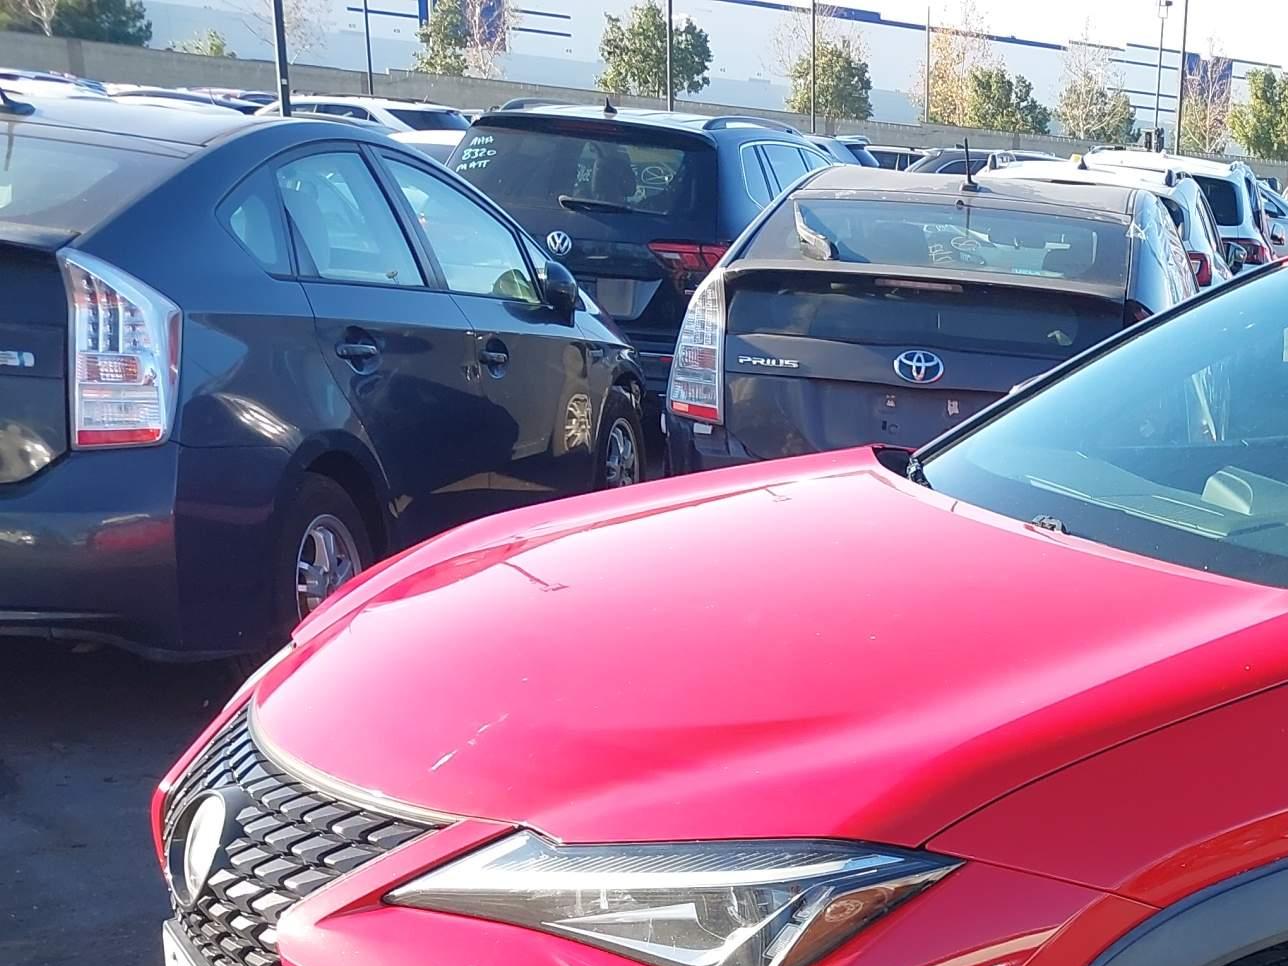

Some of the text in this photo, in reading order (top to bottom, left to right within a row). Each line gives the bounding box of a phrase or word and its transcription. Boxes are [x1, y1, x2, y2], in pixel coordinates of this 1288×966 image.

[461, 147, 497, 161] 8320
[455, 159, 491, 173] MATT
[738, 356, 799, 368] PRIUS
